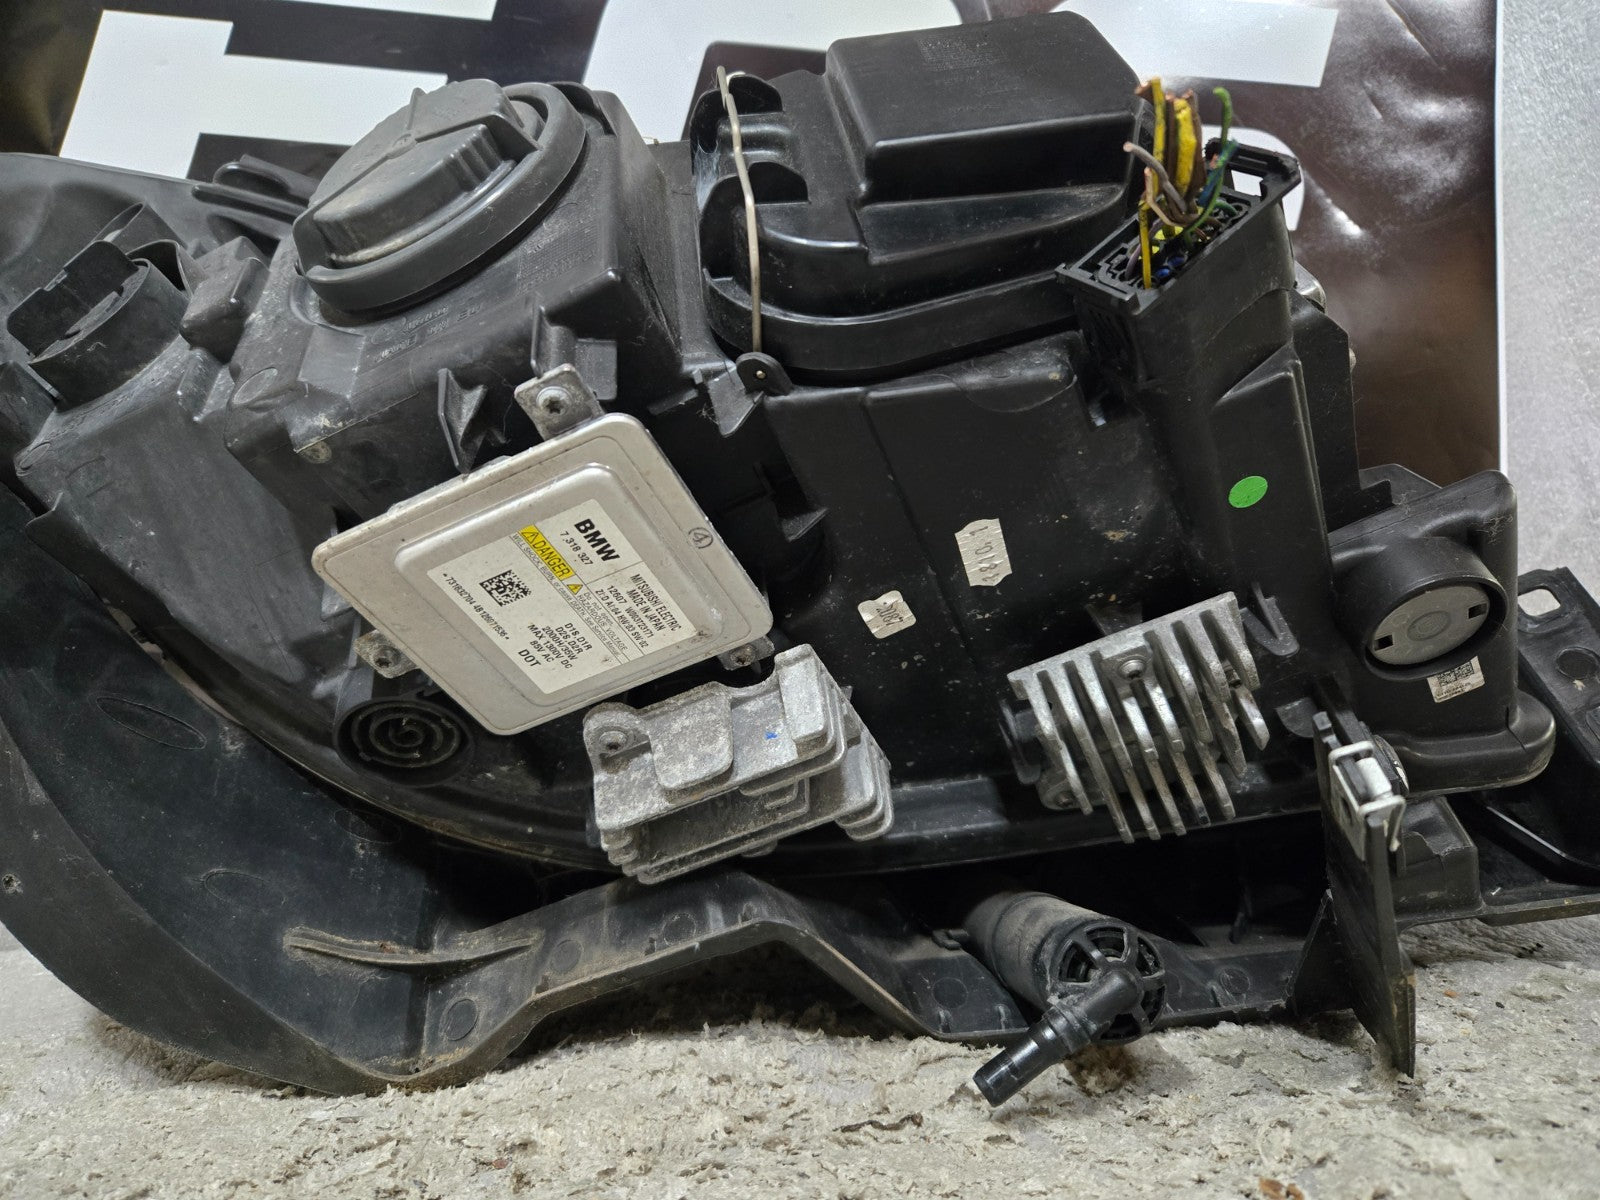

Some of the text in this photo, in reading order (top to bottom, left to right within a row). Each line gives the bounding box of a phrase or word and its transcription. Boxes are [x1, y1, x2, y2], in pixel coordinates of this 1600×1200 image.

[531, 539, 571, 577] DANGER
[573, 518, 620, 564] BMW
[576, 551, 593, 566] 327
[511, 534, 526, 547] WILL
[558, 587, 572, 601] cause
[606, 584, 627, 605] 12607
[626, 588, 646, 606] MADE
[644, 612, 666, 631] JAPAN
[629, 573, 681, 631] MITSUBISHI ELECTRIC
[526, 624, 545, 639] MAX
[542, 640, 563, 659] 1300V
[576, 594, 628, 650] HAZARDOUS VOLTAGE
[517, 648, 541, 668] DOT
